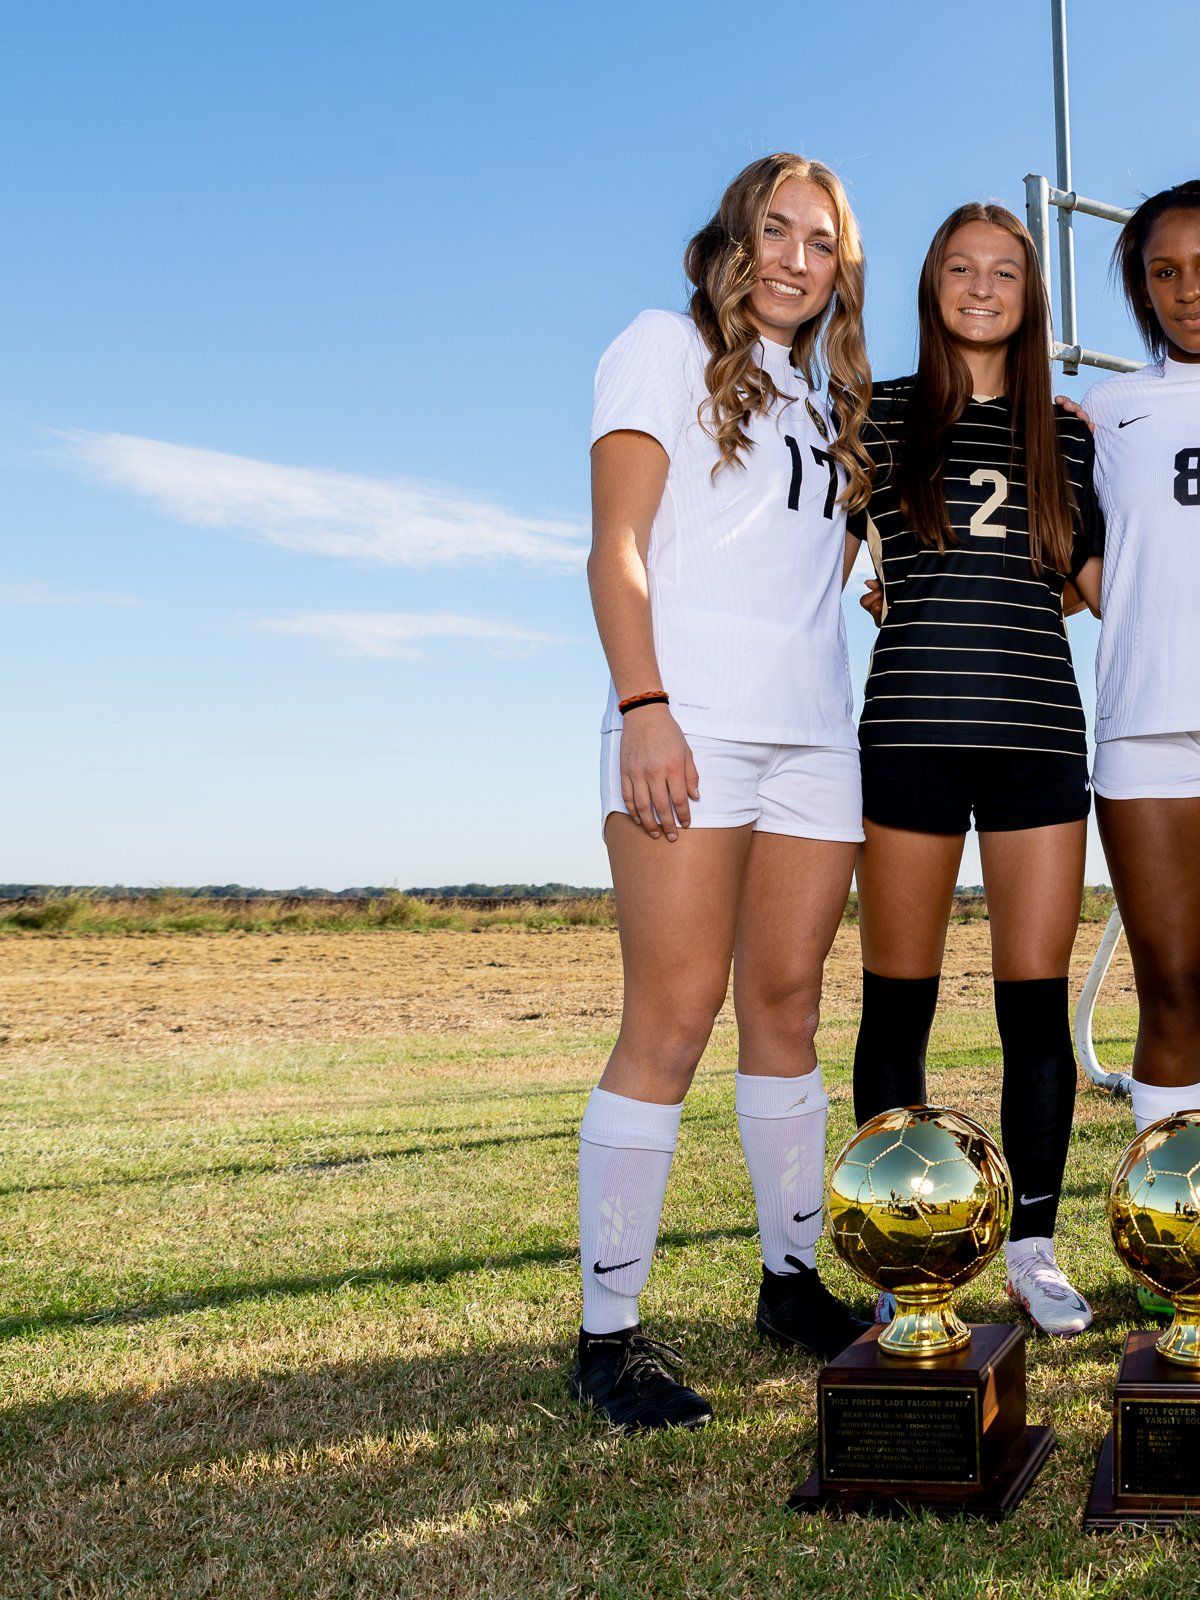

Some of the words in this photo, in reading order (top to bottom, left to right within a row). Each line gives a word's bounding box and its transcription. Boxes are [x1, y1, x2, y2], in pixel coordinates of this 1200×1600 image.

[784, 434, 839, 520] 17
[969, 468, 1008, 538] 2
[852, 1398, 881, 1407] FOSTER
[884, 1399, 903, 1408] LADY
[907, 1400, 942, 1408] FALCONS
[944, 1400, 969, 1409] STAFF
[1138, 1407, 1158, 1415] 2021
[1163, 1408, 1196, 1416] FOSTER
[1145, 1416, 1181, 1424] VARSITY
